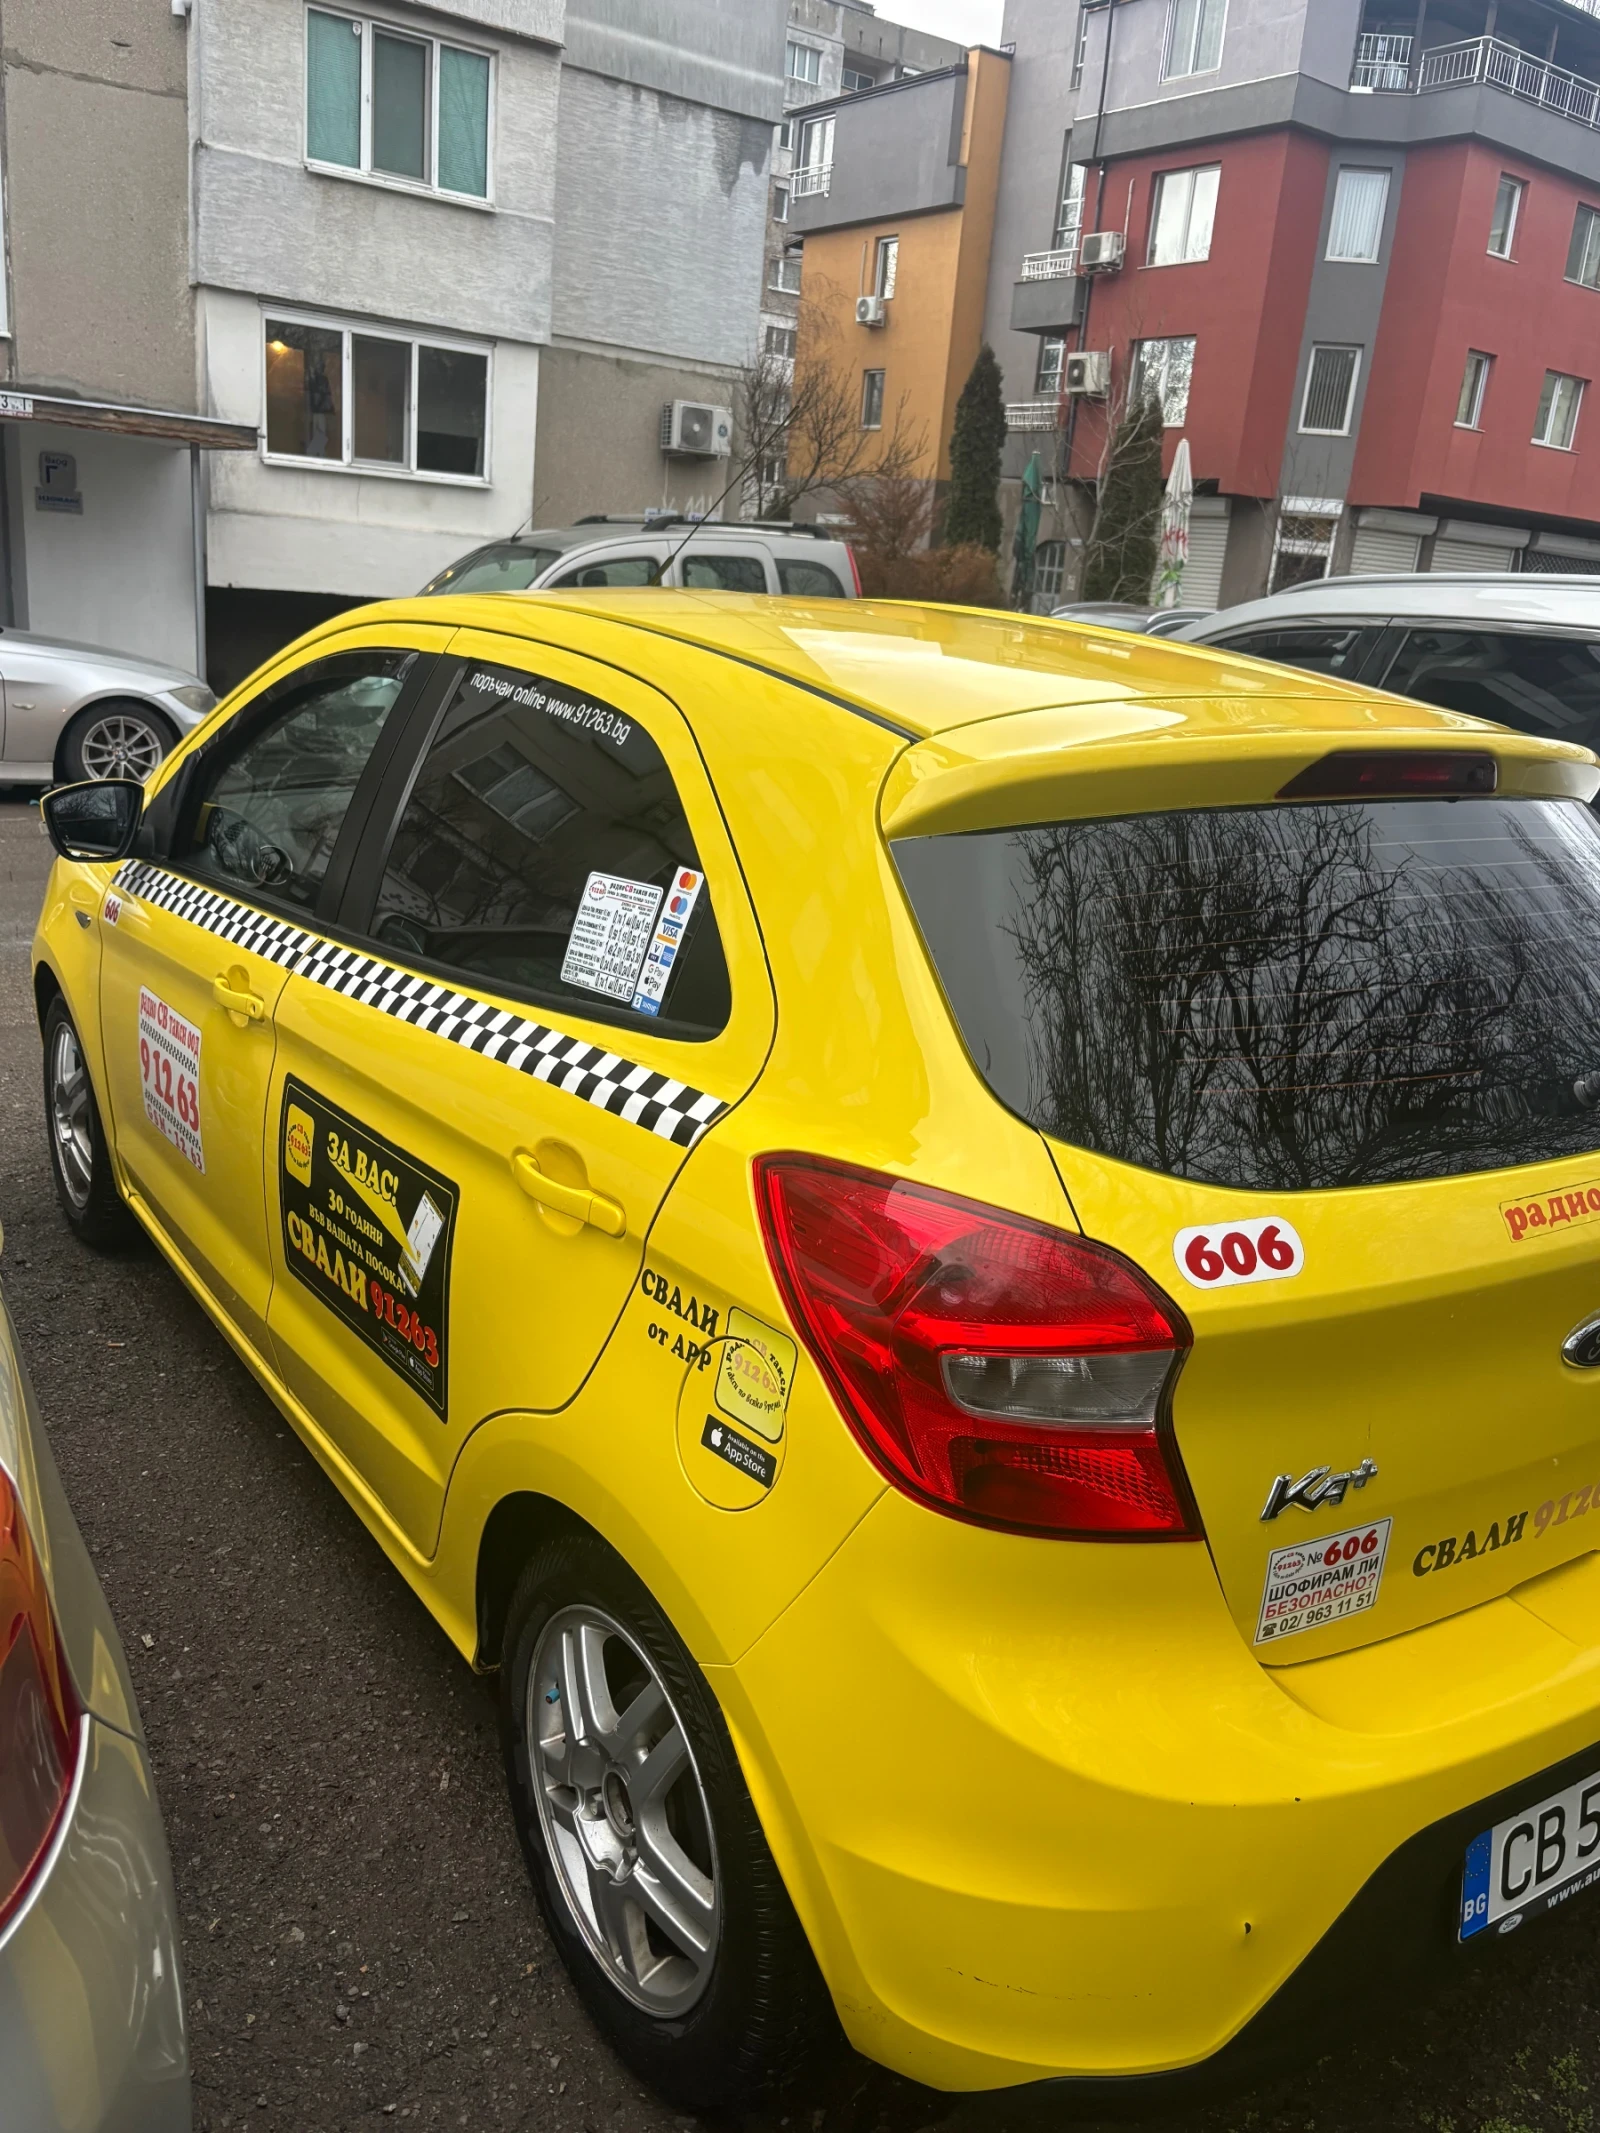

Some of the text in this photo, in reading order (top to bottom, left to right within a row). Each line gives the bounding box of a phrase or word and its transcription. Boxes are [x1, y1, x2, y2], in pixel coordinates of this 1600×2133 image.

[45, 465, 58, 483] Г
[513, 686, 546, 710] online
[545, 698, 632, 745] www.91263.bg
[105, 899, 121, 924] 606
[662, 924, 679, 939] VISA
[157, 1002, 168, 1030] СВ
[169, 1015, 187, 1046] такси
[147, 1103, 166, 1134] GSM
[327, 1131, 350, 1172] ЗА
[354, 1148, 399, 1207] ВАС!
[328, 1188, 343, 1215] 30
[345, 1204, 383, 1248] ГОДИНИ
[1505, 1188, 1600, 1240] радио
[309, 1202, 326, 1228] ВЪВ
[326, 1216, 365, 1258] ВАШАТА
[365, 1251, 407, 1295] ПОСОКА!
[1184, 1224, 1295, 1282] 606
[287, 1210, 439, 1367] СВАЛИ 91263
[641, 1268, 719, 1338] СВАЛИ
[647, 1322, 712, 1372] от APP
[769, 1353, 786, 1397] такси
[724, 1443, 767, 1478] App Store
[727, 1433, 750, 1454] Available
[1277, 1560, 1302, 1571] 91263
[1322, 1528, 1379, 1566] 606
[1412, 1511, 1529, 1578] СВАЛИ
[1265, 1573, 1376, 1619] БЕЗОПАСНО?
[1268, 1564, 1355, 1602] ШОФИРАМ
[1357, 1556, 1380, 1576] ЛИ
[1279, 1591, 1373, 1632] 02/ 963 11 51
[1464, 1893, 1487, 1923] BG
